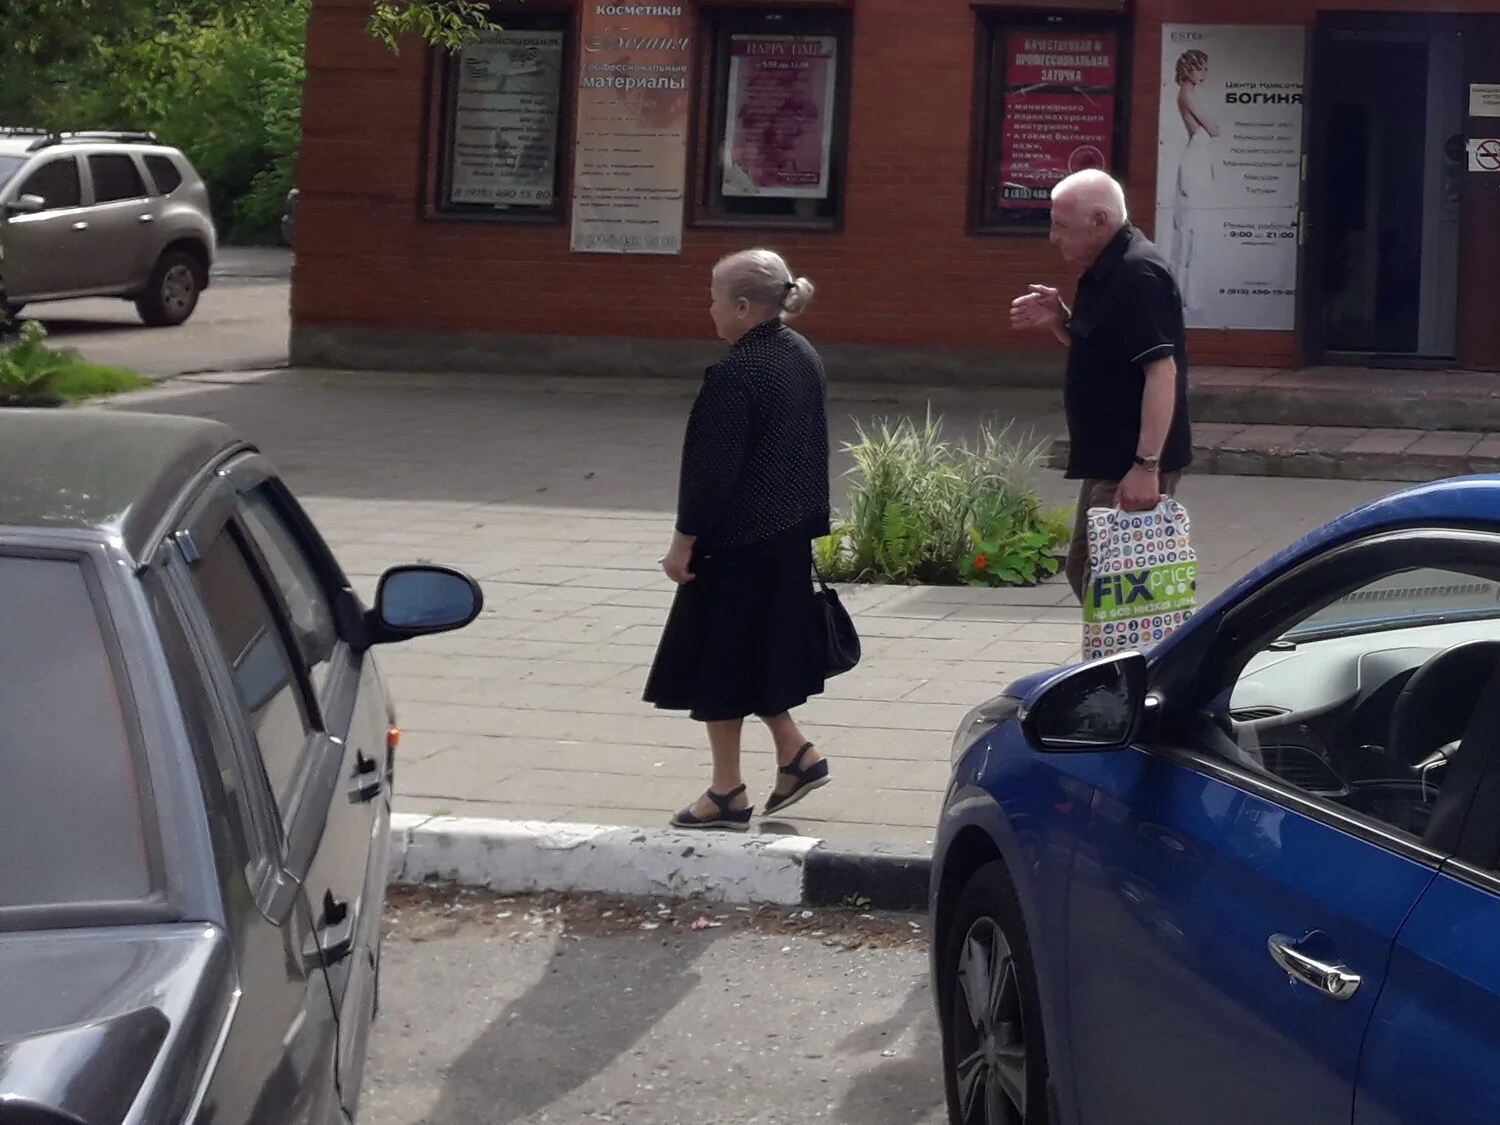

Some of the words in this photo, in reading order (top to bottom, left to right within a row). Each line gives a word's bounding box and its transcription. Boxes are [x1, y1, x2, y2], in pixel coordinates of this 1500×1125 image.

[1171, 32, 1204, 40] ESTEL
[1041, 69, 1082, 82] ЗАТОЧКА
[583, 76, 685, 91] материалы
[1225, 81, 1257, 89] Центр
[1225, 92, 1303, 105] БОГИНЯ
[1150, 566, 1195, 591] price
